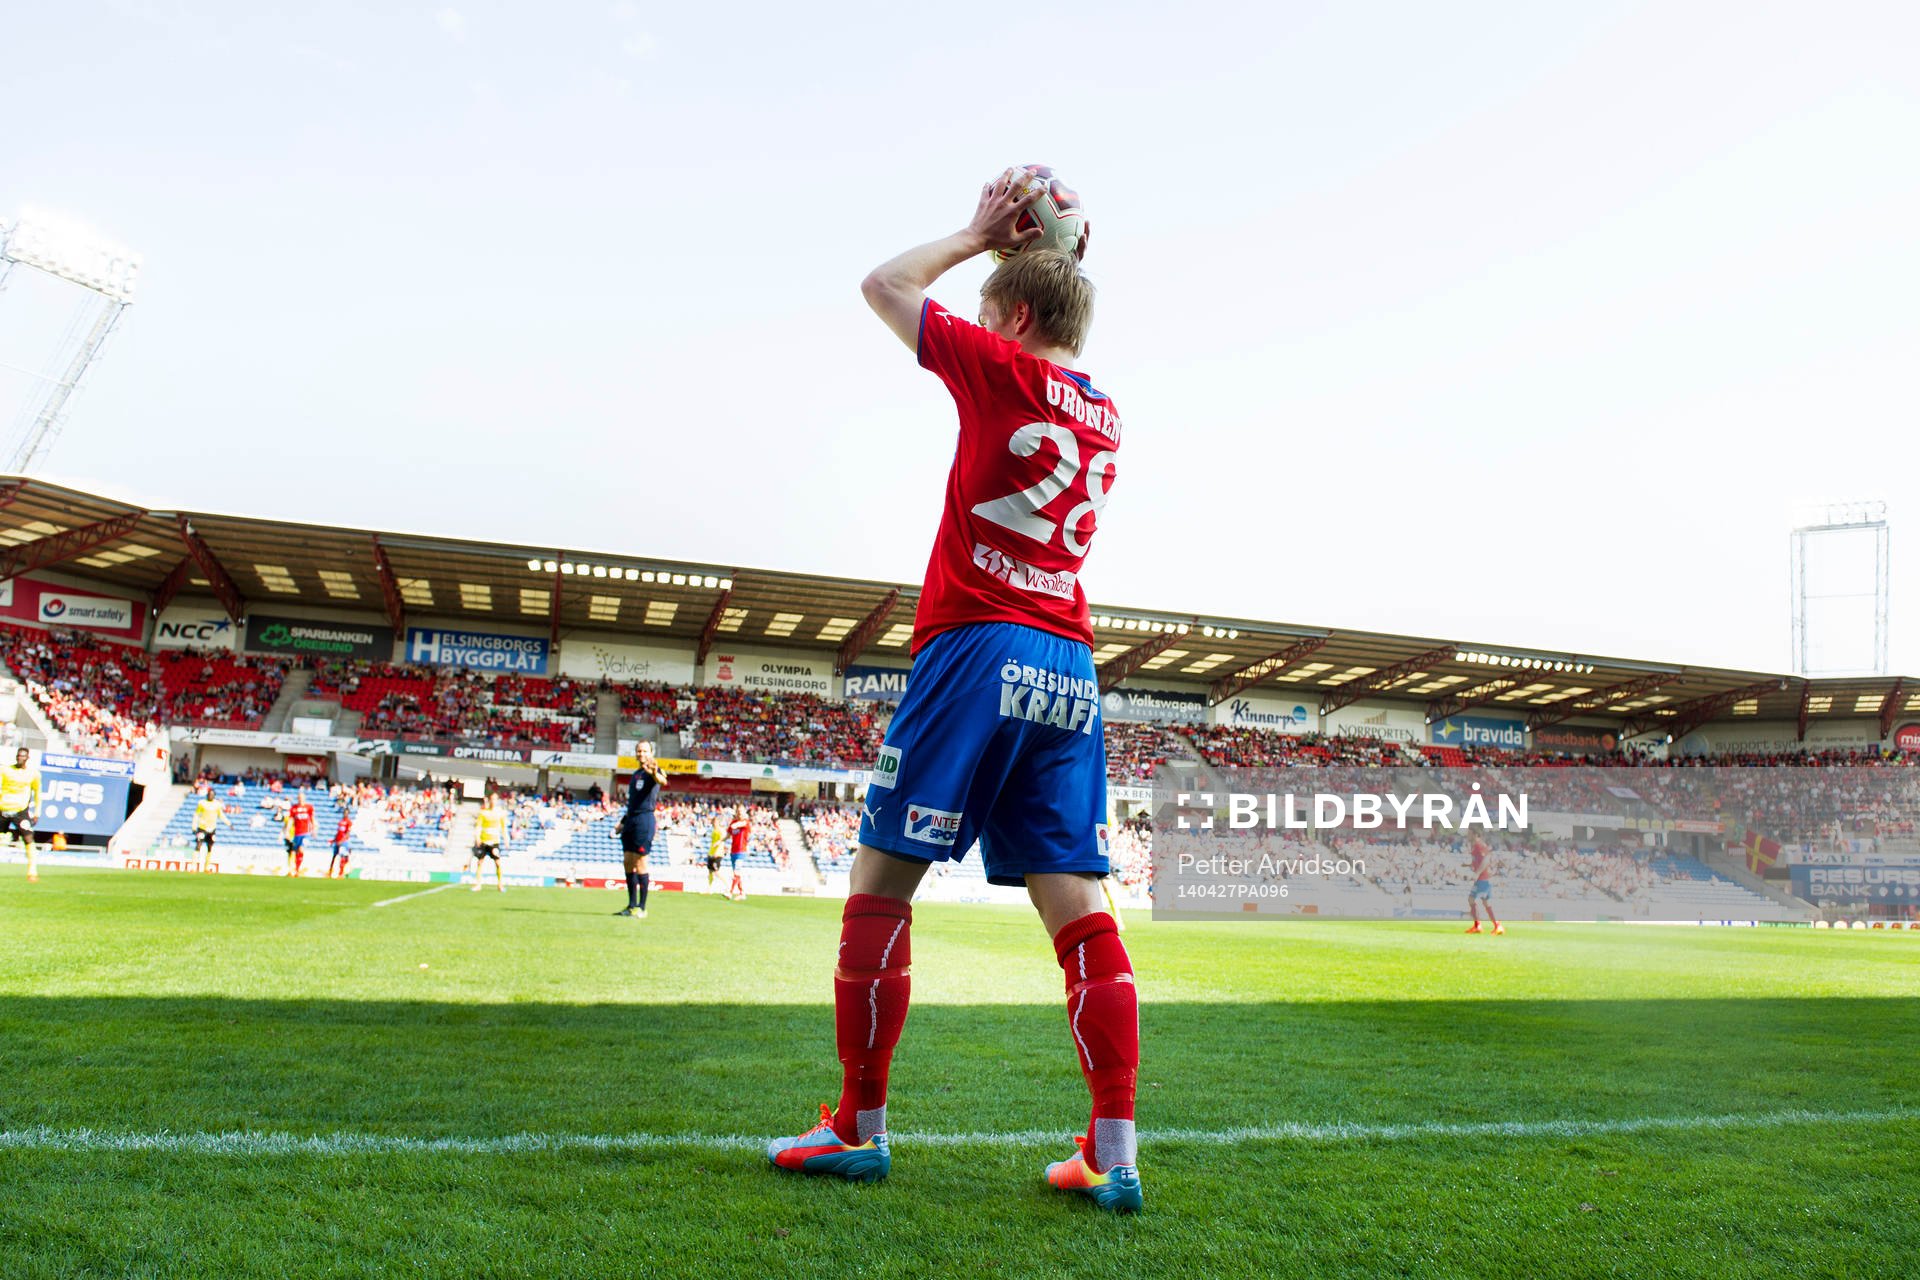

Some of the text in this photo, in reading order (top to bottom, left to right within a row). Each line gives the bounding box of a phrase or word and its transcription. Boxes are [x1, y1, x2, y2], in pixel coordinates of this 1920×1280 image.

[1047, 375, 1122, 444] URONEN
[971, 422, 1117, 557] 28
[68, 607, 125, 622] smart safety
[159, 622, 215, 641] NCC
[291, 627, 373, 644] SPARBANKEN
[412, 631, 541, 662] HELSINGBORGS
[441, 648, 540, 670] BYGGPLÅT
[602, 655, 651, 675] Valvet
[761, 664, 812, 676] OLYMPIA
[745, 676, 827, 690] HELSINGBORG
[1000, 683, 1098, 735] KRAFT
[1128, 693, 1202, 712] Volkswagen
[1338, 723, 1415, 740] NORRPORTEN
[1464, 722, 1523, 744] bravida
[1536, 730, 1599, 748] Swedbank
[1716, 738, 1769, 751] support
[454, 747, 522, 761] OPTIMERA
[875, 754, 898, 773] LID
[929, 829, 957, 841] SPO
[1809, 868, 1920, 884] RESURS
[1810, 884, 1871, 896] BANK
